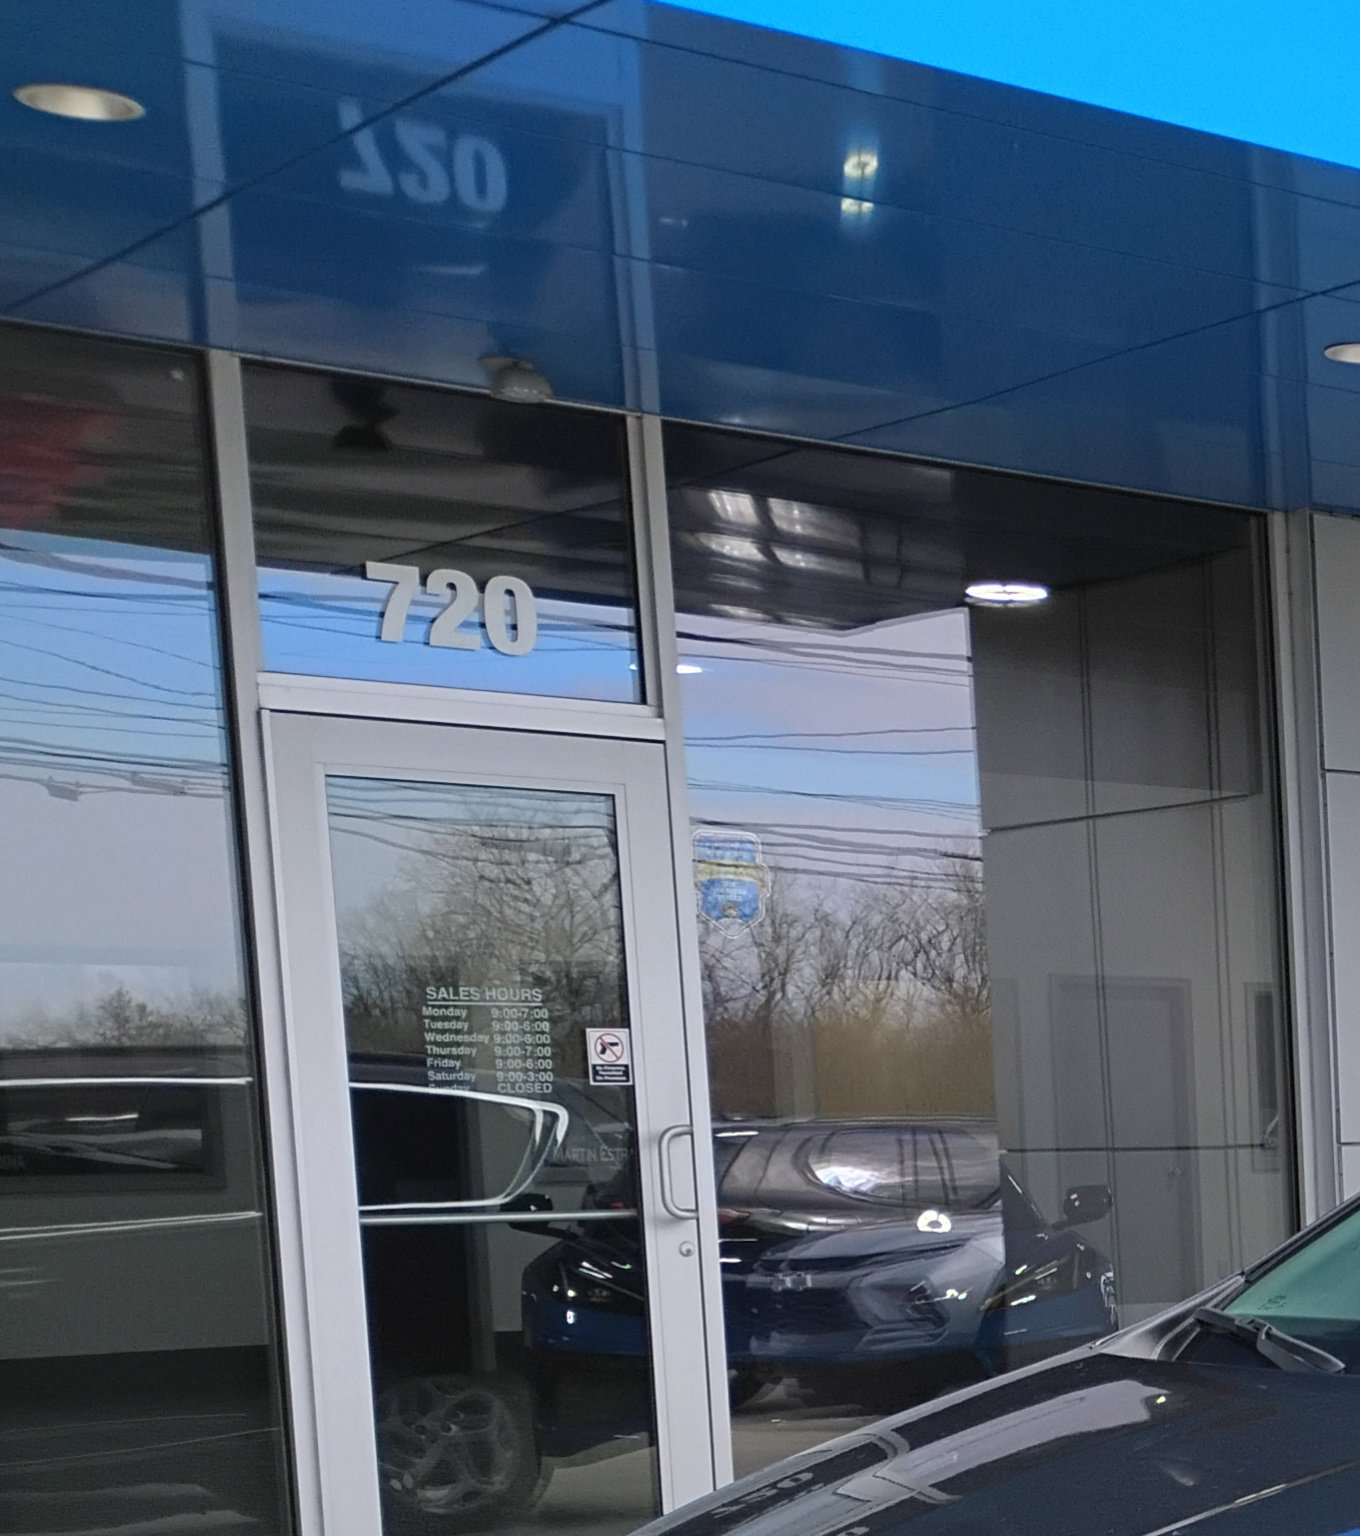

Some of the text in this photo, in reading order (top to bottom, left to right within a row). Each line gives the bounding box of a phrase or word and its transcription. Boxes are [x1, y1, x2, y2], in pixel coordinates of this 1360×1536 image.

[365, 560, 537, 656] 720
[426, 986, 543, 1001] SALES HOURS
[422, 1006, 549, 1019] Monday 9:00-7:00
[423, 1019, 469, 1031] Tuesday
[424, 1032, 490, 1044] Wednesday
[425, 1045, 552, 1057] Thursday 9:00-7:00
[426, 1057, 461, 1070] Friday
[427, 1070, 477, 1082] Saturday
[497, 1083, 553, 1094] CLOSED
